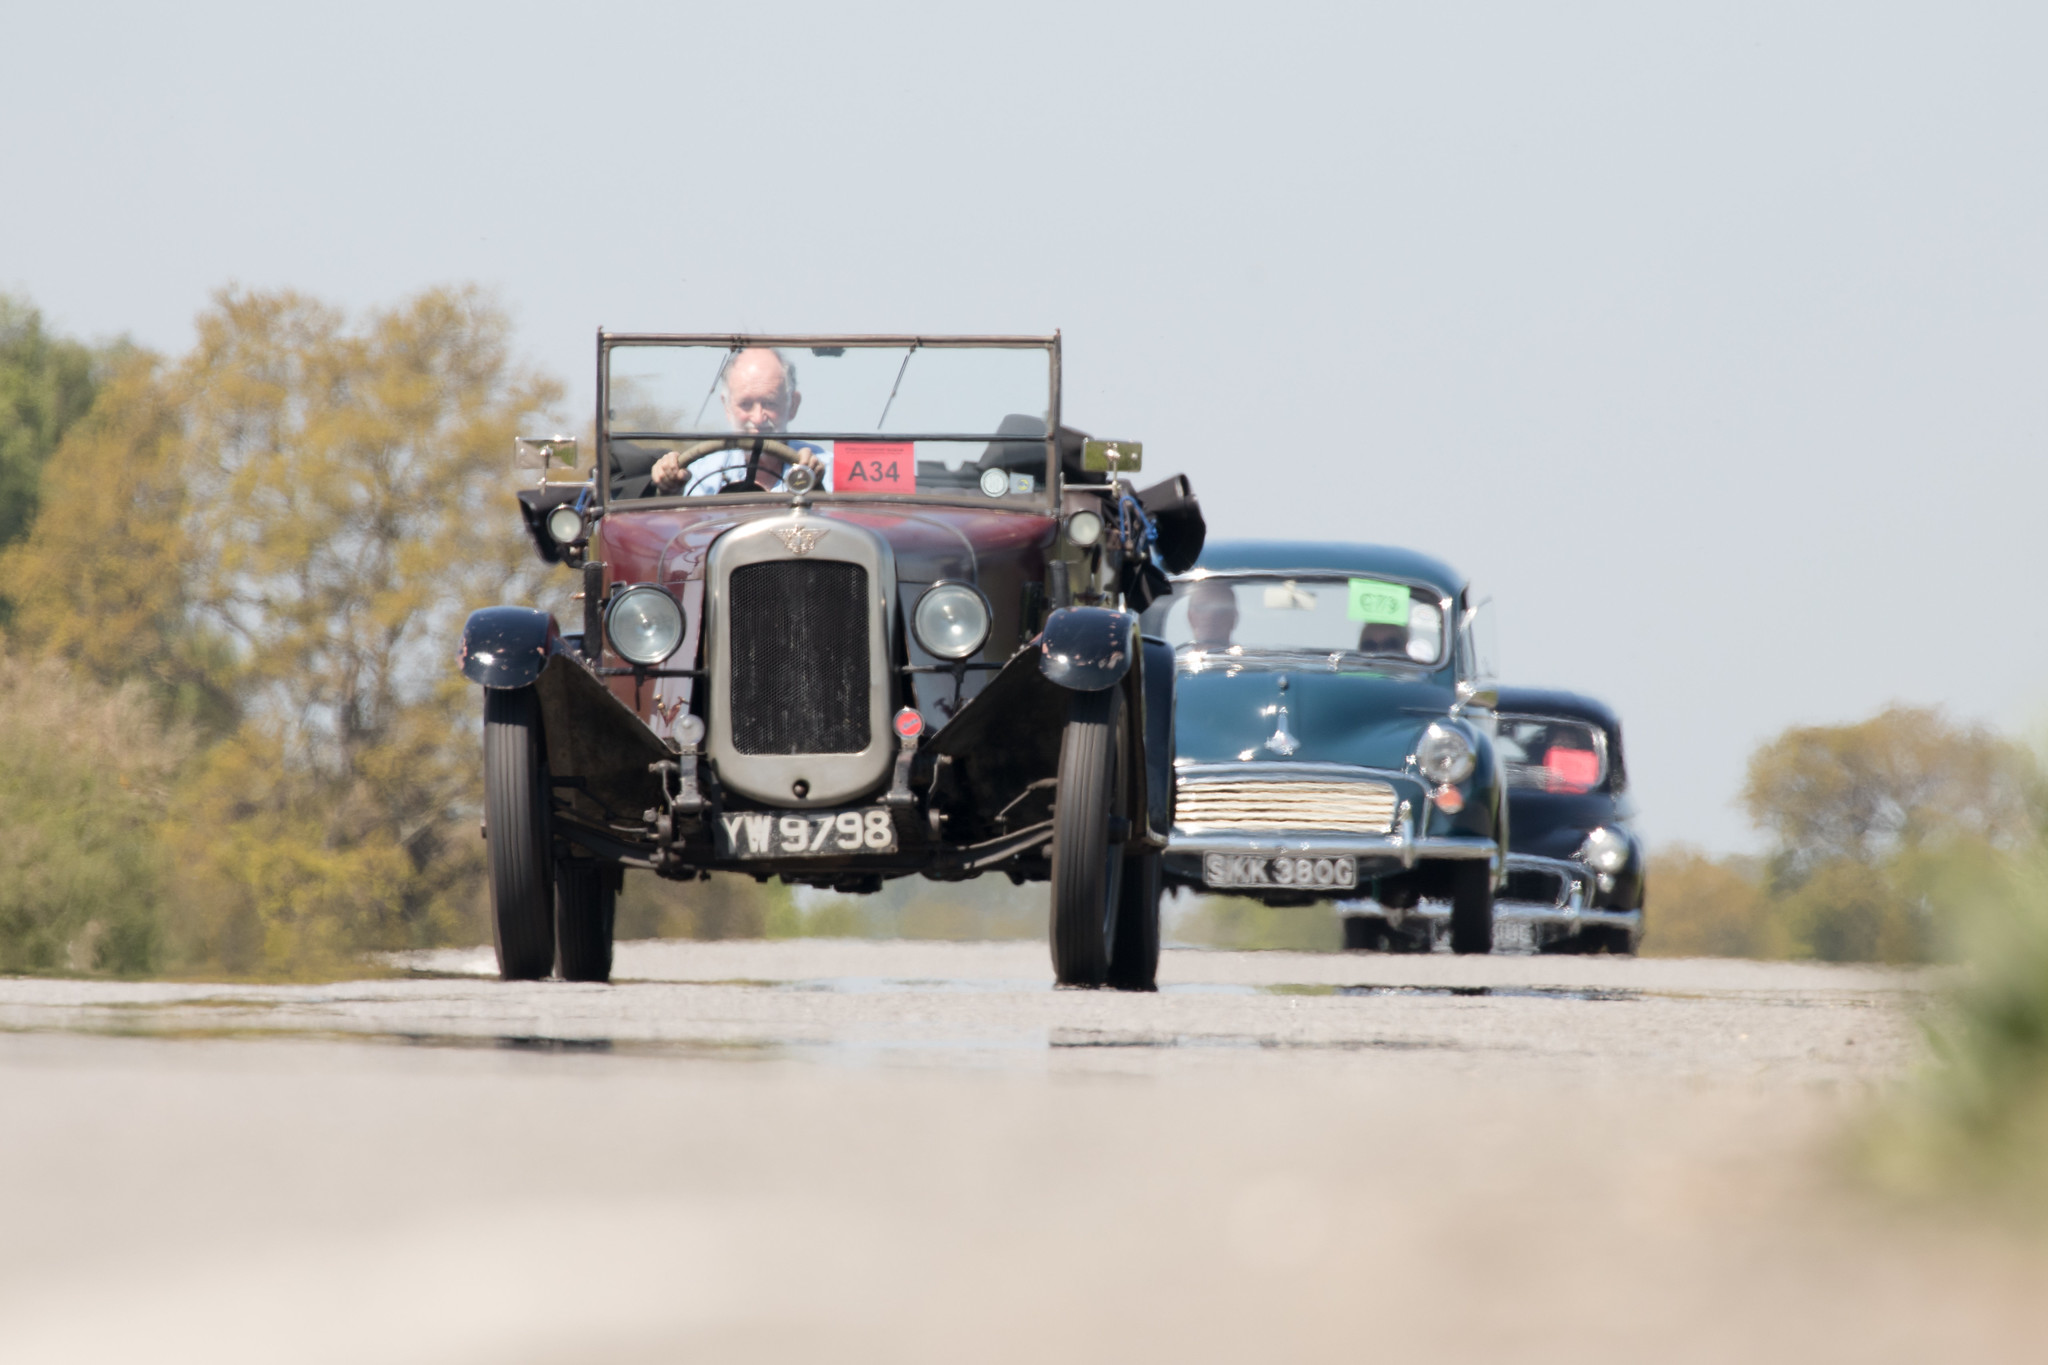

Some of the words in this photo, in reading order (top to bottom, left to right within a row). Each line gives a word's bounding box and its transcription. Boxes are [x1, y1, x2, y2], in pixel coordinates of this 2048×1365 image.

[848, 461, 900, 482] A34
[722, 815, 772, 853] YW
[779, 810, 892, 852] 9798
[1206, 853, 1269, 884] SKK
[1272, 856, 1353, 885] 380G
